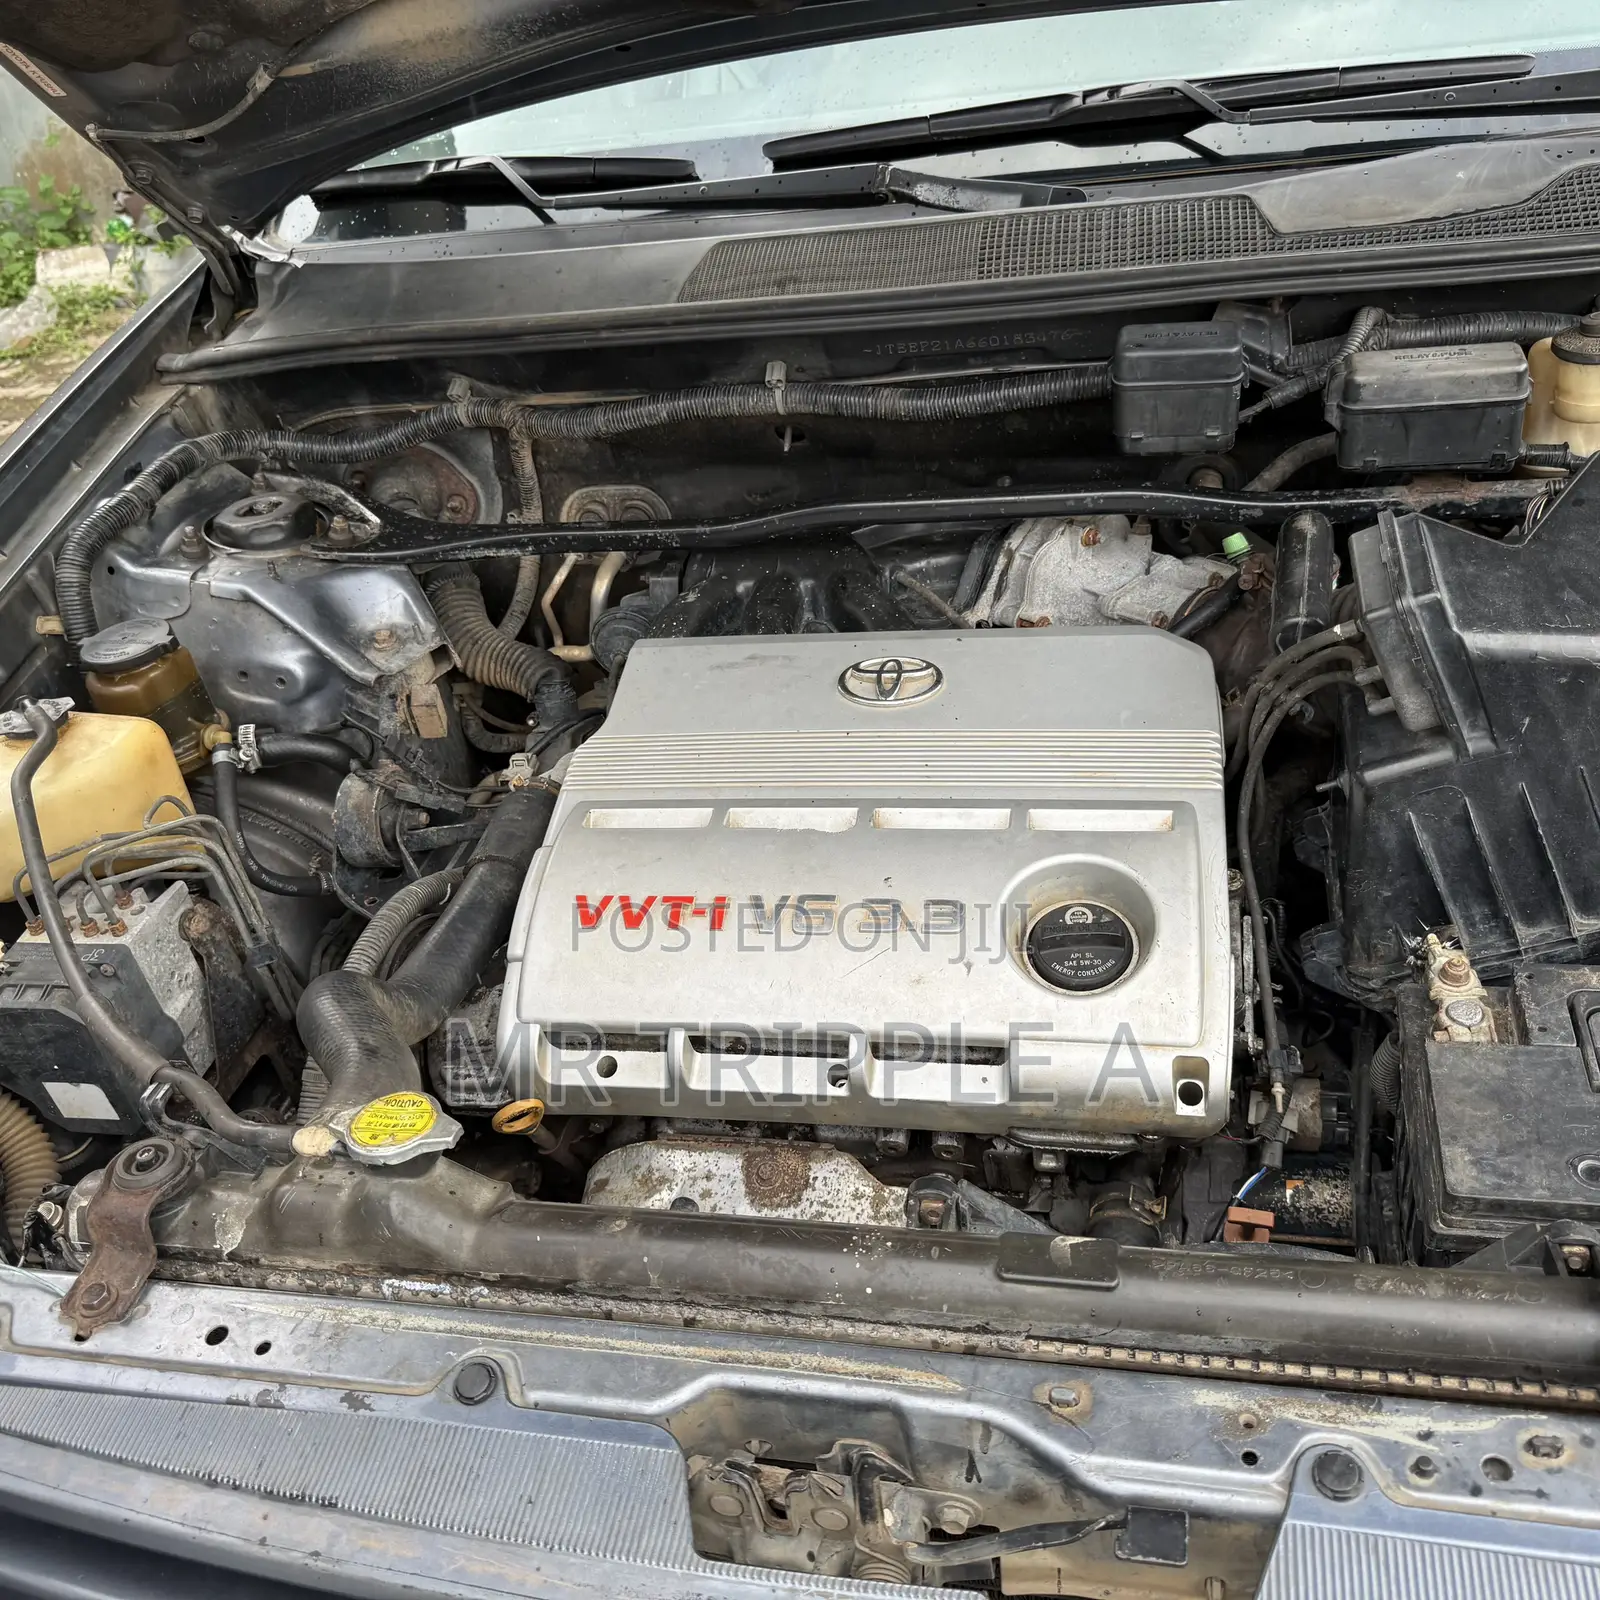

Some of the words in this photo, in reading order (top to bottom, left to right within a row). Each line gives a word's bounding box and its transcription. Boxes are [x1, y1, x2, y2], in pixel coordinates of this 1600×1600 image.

[1051, 962, 1075, 976] ENERGY
[1077, 959, 1116, 977] CONSERVING
[383, 1099, 423, 1108] CAUTION
